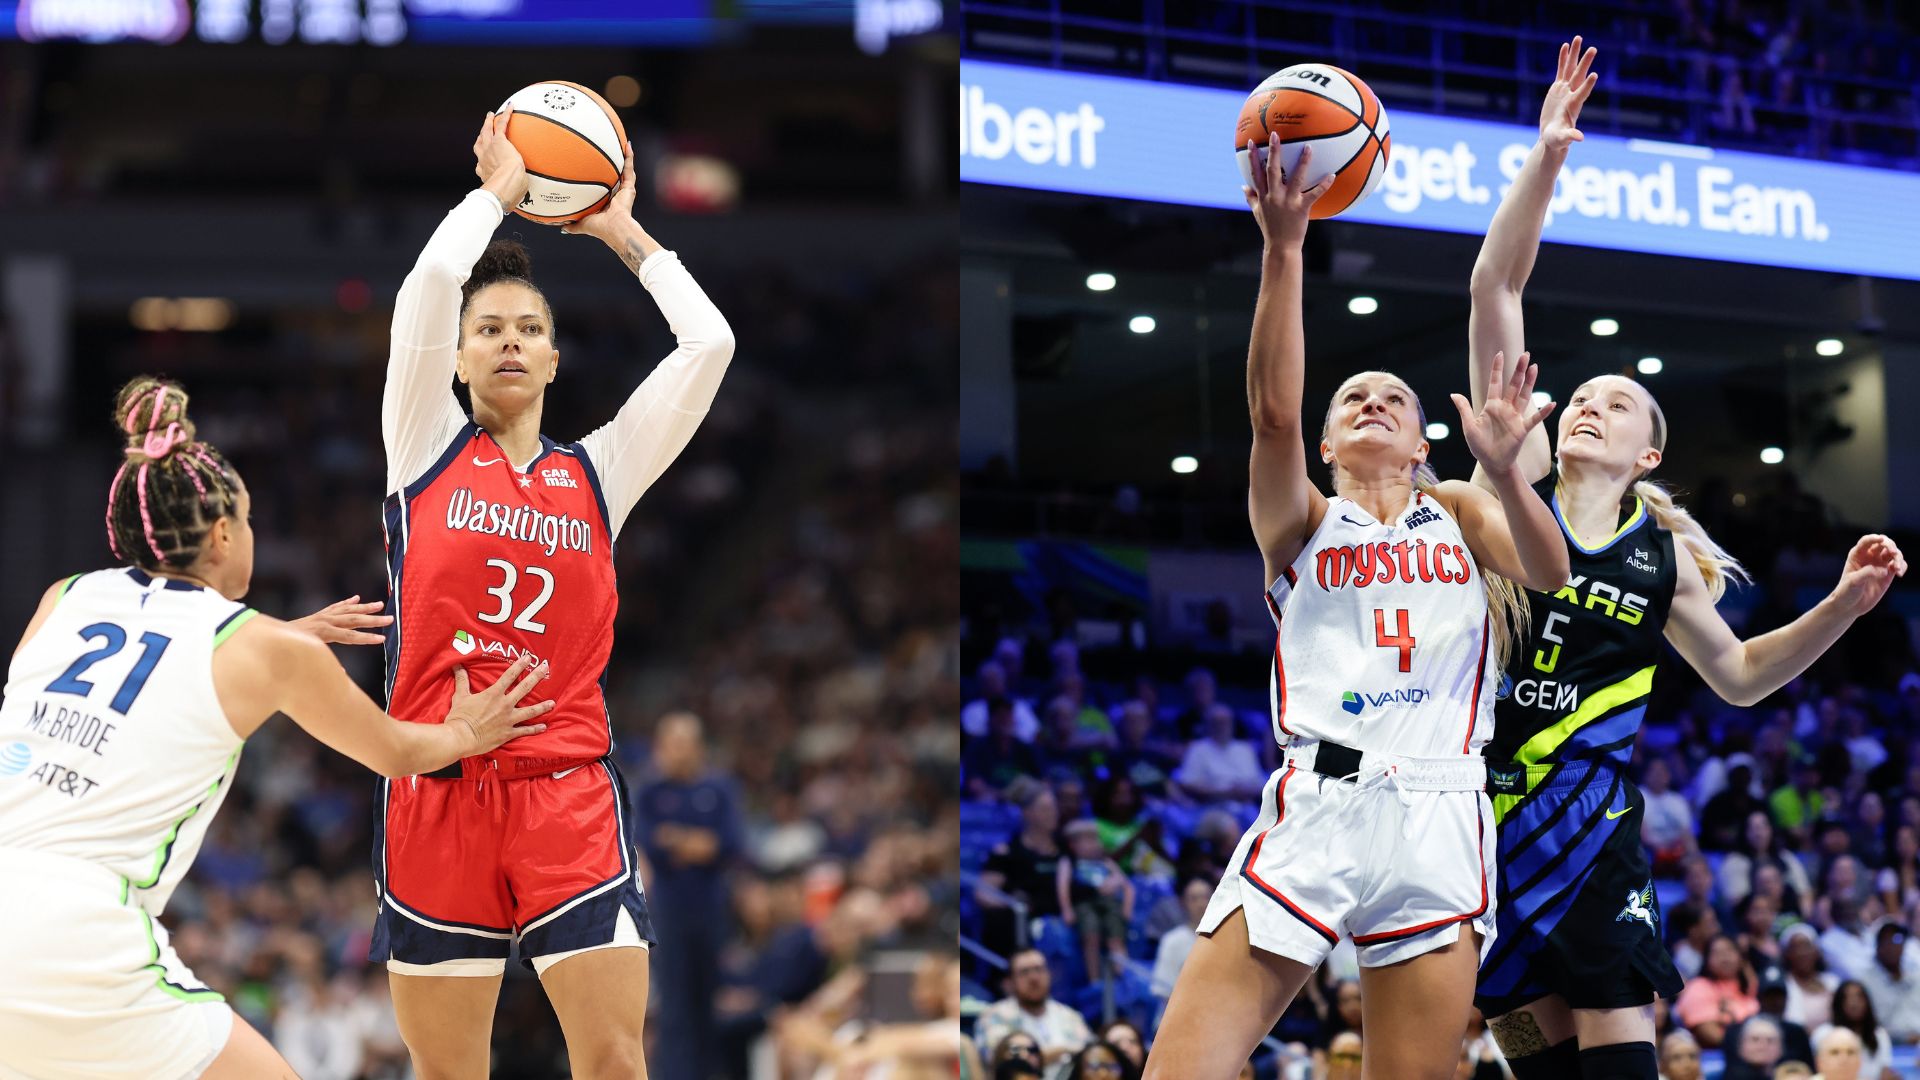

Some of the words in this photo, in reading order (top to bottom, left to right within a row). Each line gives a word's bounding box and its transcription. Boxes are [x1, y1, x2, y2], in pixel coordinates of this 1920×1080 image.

[1375, 140, 1491, 214] get.
[1697, 165, 1830, 242] Earn.
[541, 468, 570, 479] CAR
[545, 476, 578, 489] max
[1405, 506, 1432, 523] CAR
[1406, 513, 1443, 530] max
[1625, 555, 1658, 574] Albert
[477, 558, 555, 634] 32
[1541, 573, 1649, 626] XAS
[1373, 608, 1416, 673] 4
[1533, 610, 1571, 673] 5
[44, 621, 172, 716] 21
[1514, 678, 1579, 712] GEM
[24, 700, 116, 756] McBRIDE
[28, 762, 99, 798] AT&T
